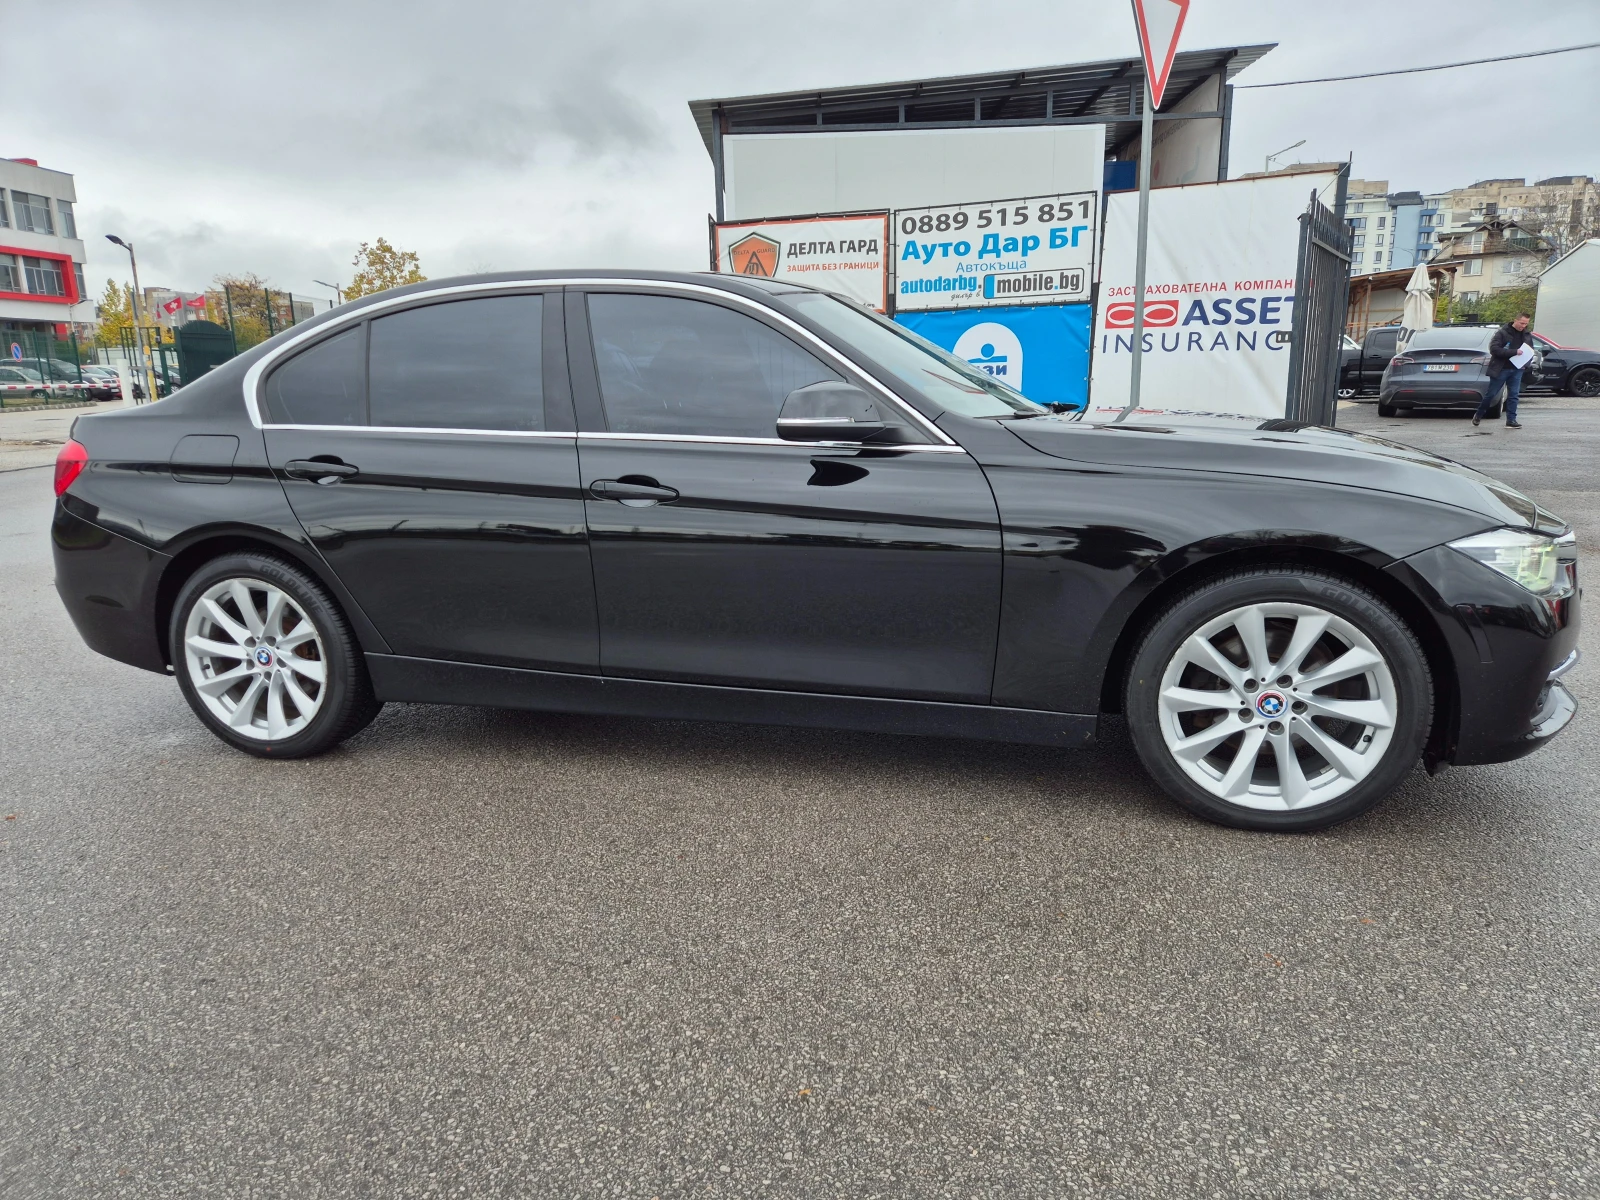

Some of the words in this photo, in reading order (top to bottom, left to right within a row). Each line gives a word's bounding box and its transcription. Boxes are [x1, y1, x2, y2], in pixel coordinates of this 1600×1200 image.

[901, 211, 969, 235] 0889
[977, 205, 1029, 229] 515
[1037, 200, 1090, 223] 851
[787, 240, 838, 258] ДЕЛТА
[839, 238, 879, 255] ГАРД
[901, 239, 972, 265] Ауто
[978, 232, 1041, 260] Дар
[1049, 225, 1088, 249] БГ
[786, 263, 821, 273] ЗАЩИТА
[823, 262, 837, 271] БЕЗ
[839, 261, 879, 271] ГРАНИЦИ
[956, 259, 1027, 274] Автокъща
[996, 271, 1080, 295] mobile.bg
[1108, 281, 1228, 297] ЗАСТАХОВАТЕЛНА
[1234, 278, 1314, 291] КОМПАН
[1102, 330, 1284, 354] INSURANC
[977, 364, 1008, 376] ЗИ
[259, 564, 324, 614] GOLDLINE
